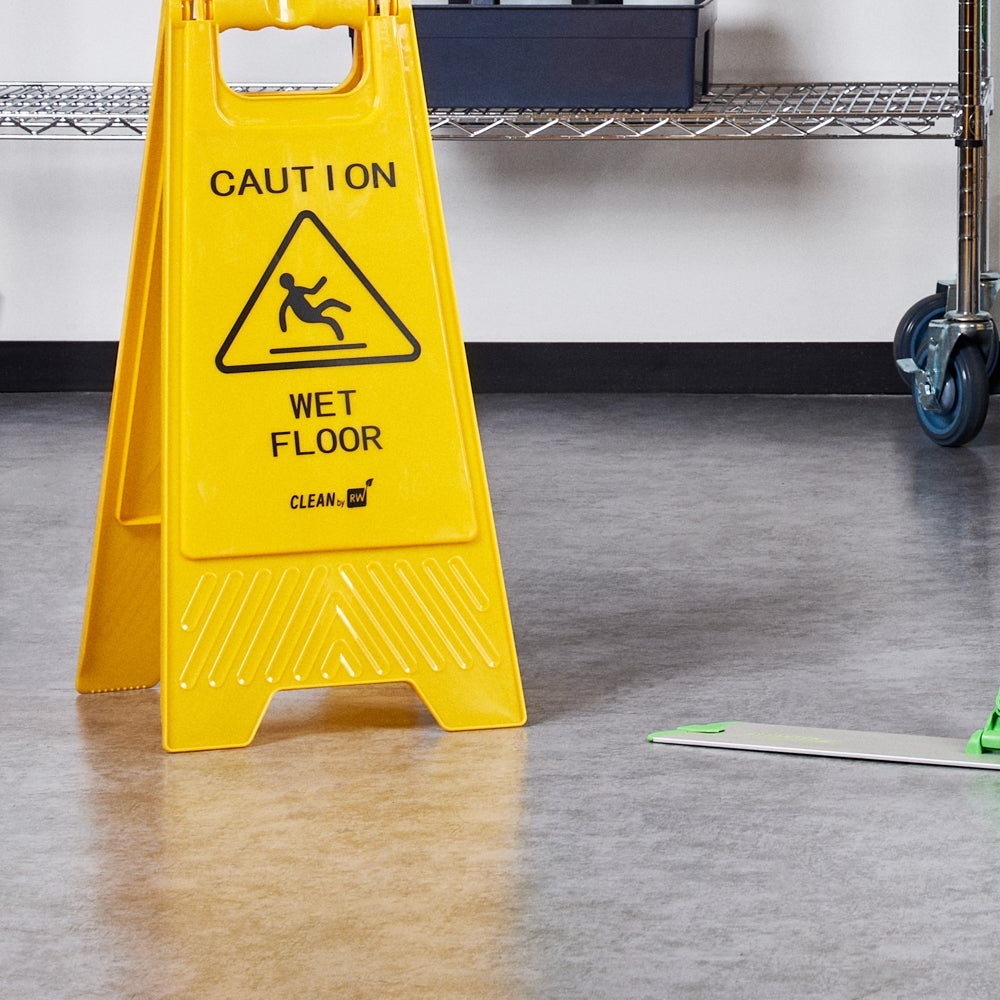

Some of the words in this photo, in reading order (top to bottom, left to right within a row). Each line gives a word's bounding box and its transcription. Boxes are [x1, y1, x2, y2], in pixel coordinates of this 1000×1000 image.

[209, 161, 397, 197] CAUTION
[289, 389, 357, 419] WET
[271, 425, 383, 457] FLOOR
[290, 492, 336, 509] CLEAN
[336, 499, 345, 508] by
